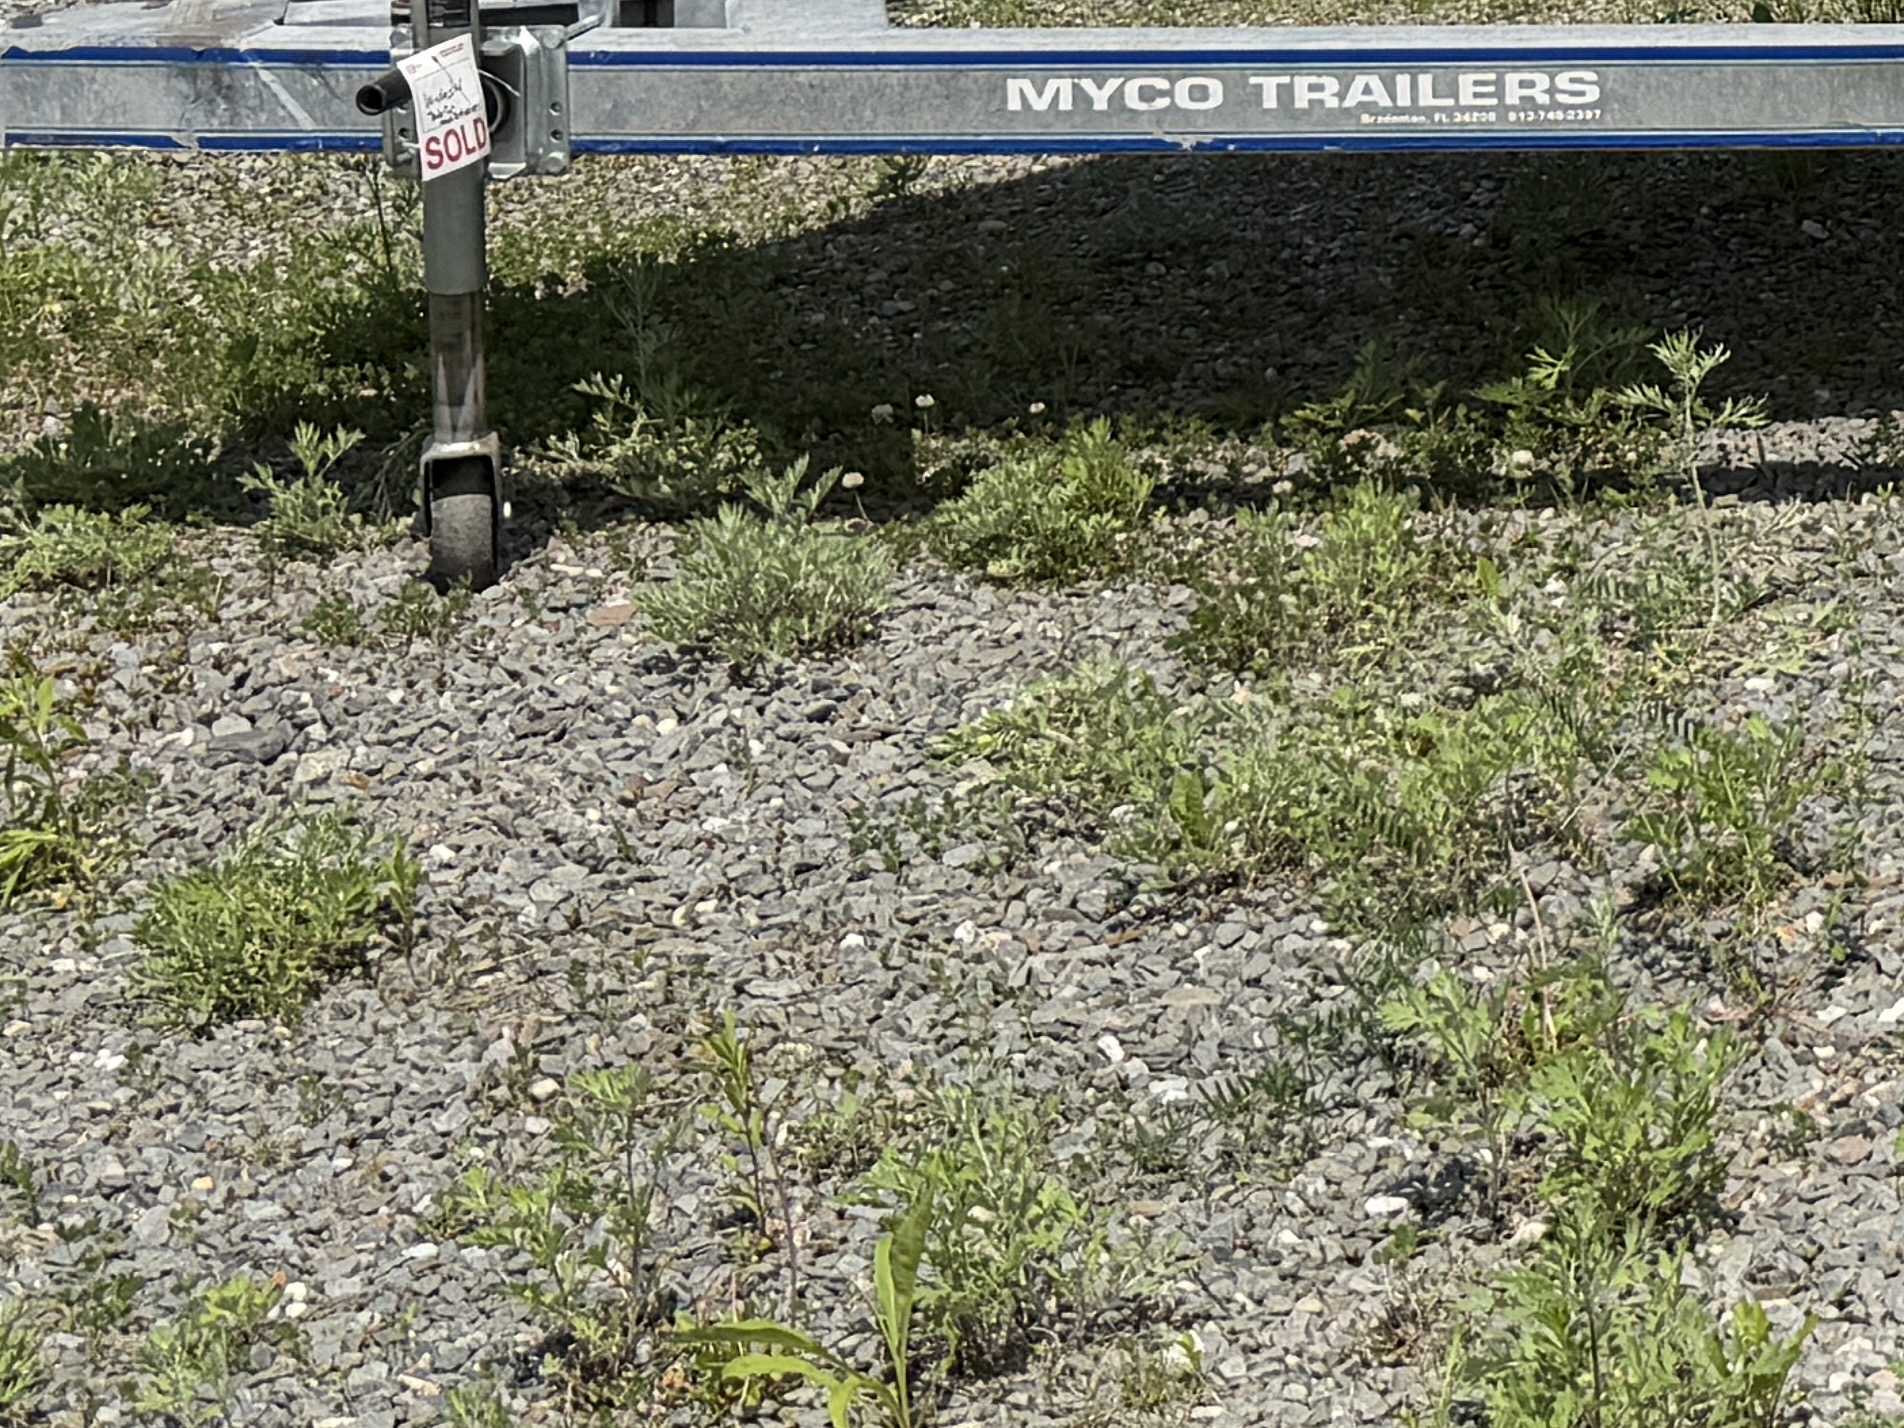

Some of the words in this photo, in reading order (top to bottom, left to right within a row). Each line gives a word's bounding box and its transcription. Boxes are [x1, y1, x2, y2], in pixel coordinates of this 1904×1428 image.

[1006, 75, 1225, 112] MYCO
[1249, 70, 1602, 111] TRAILERS
[425, 116, 488, 171] SOLD
